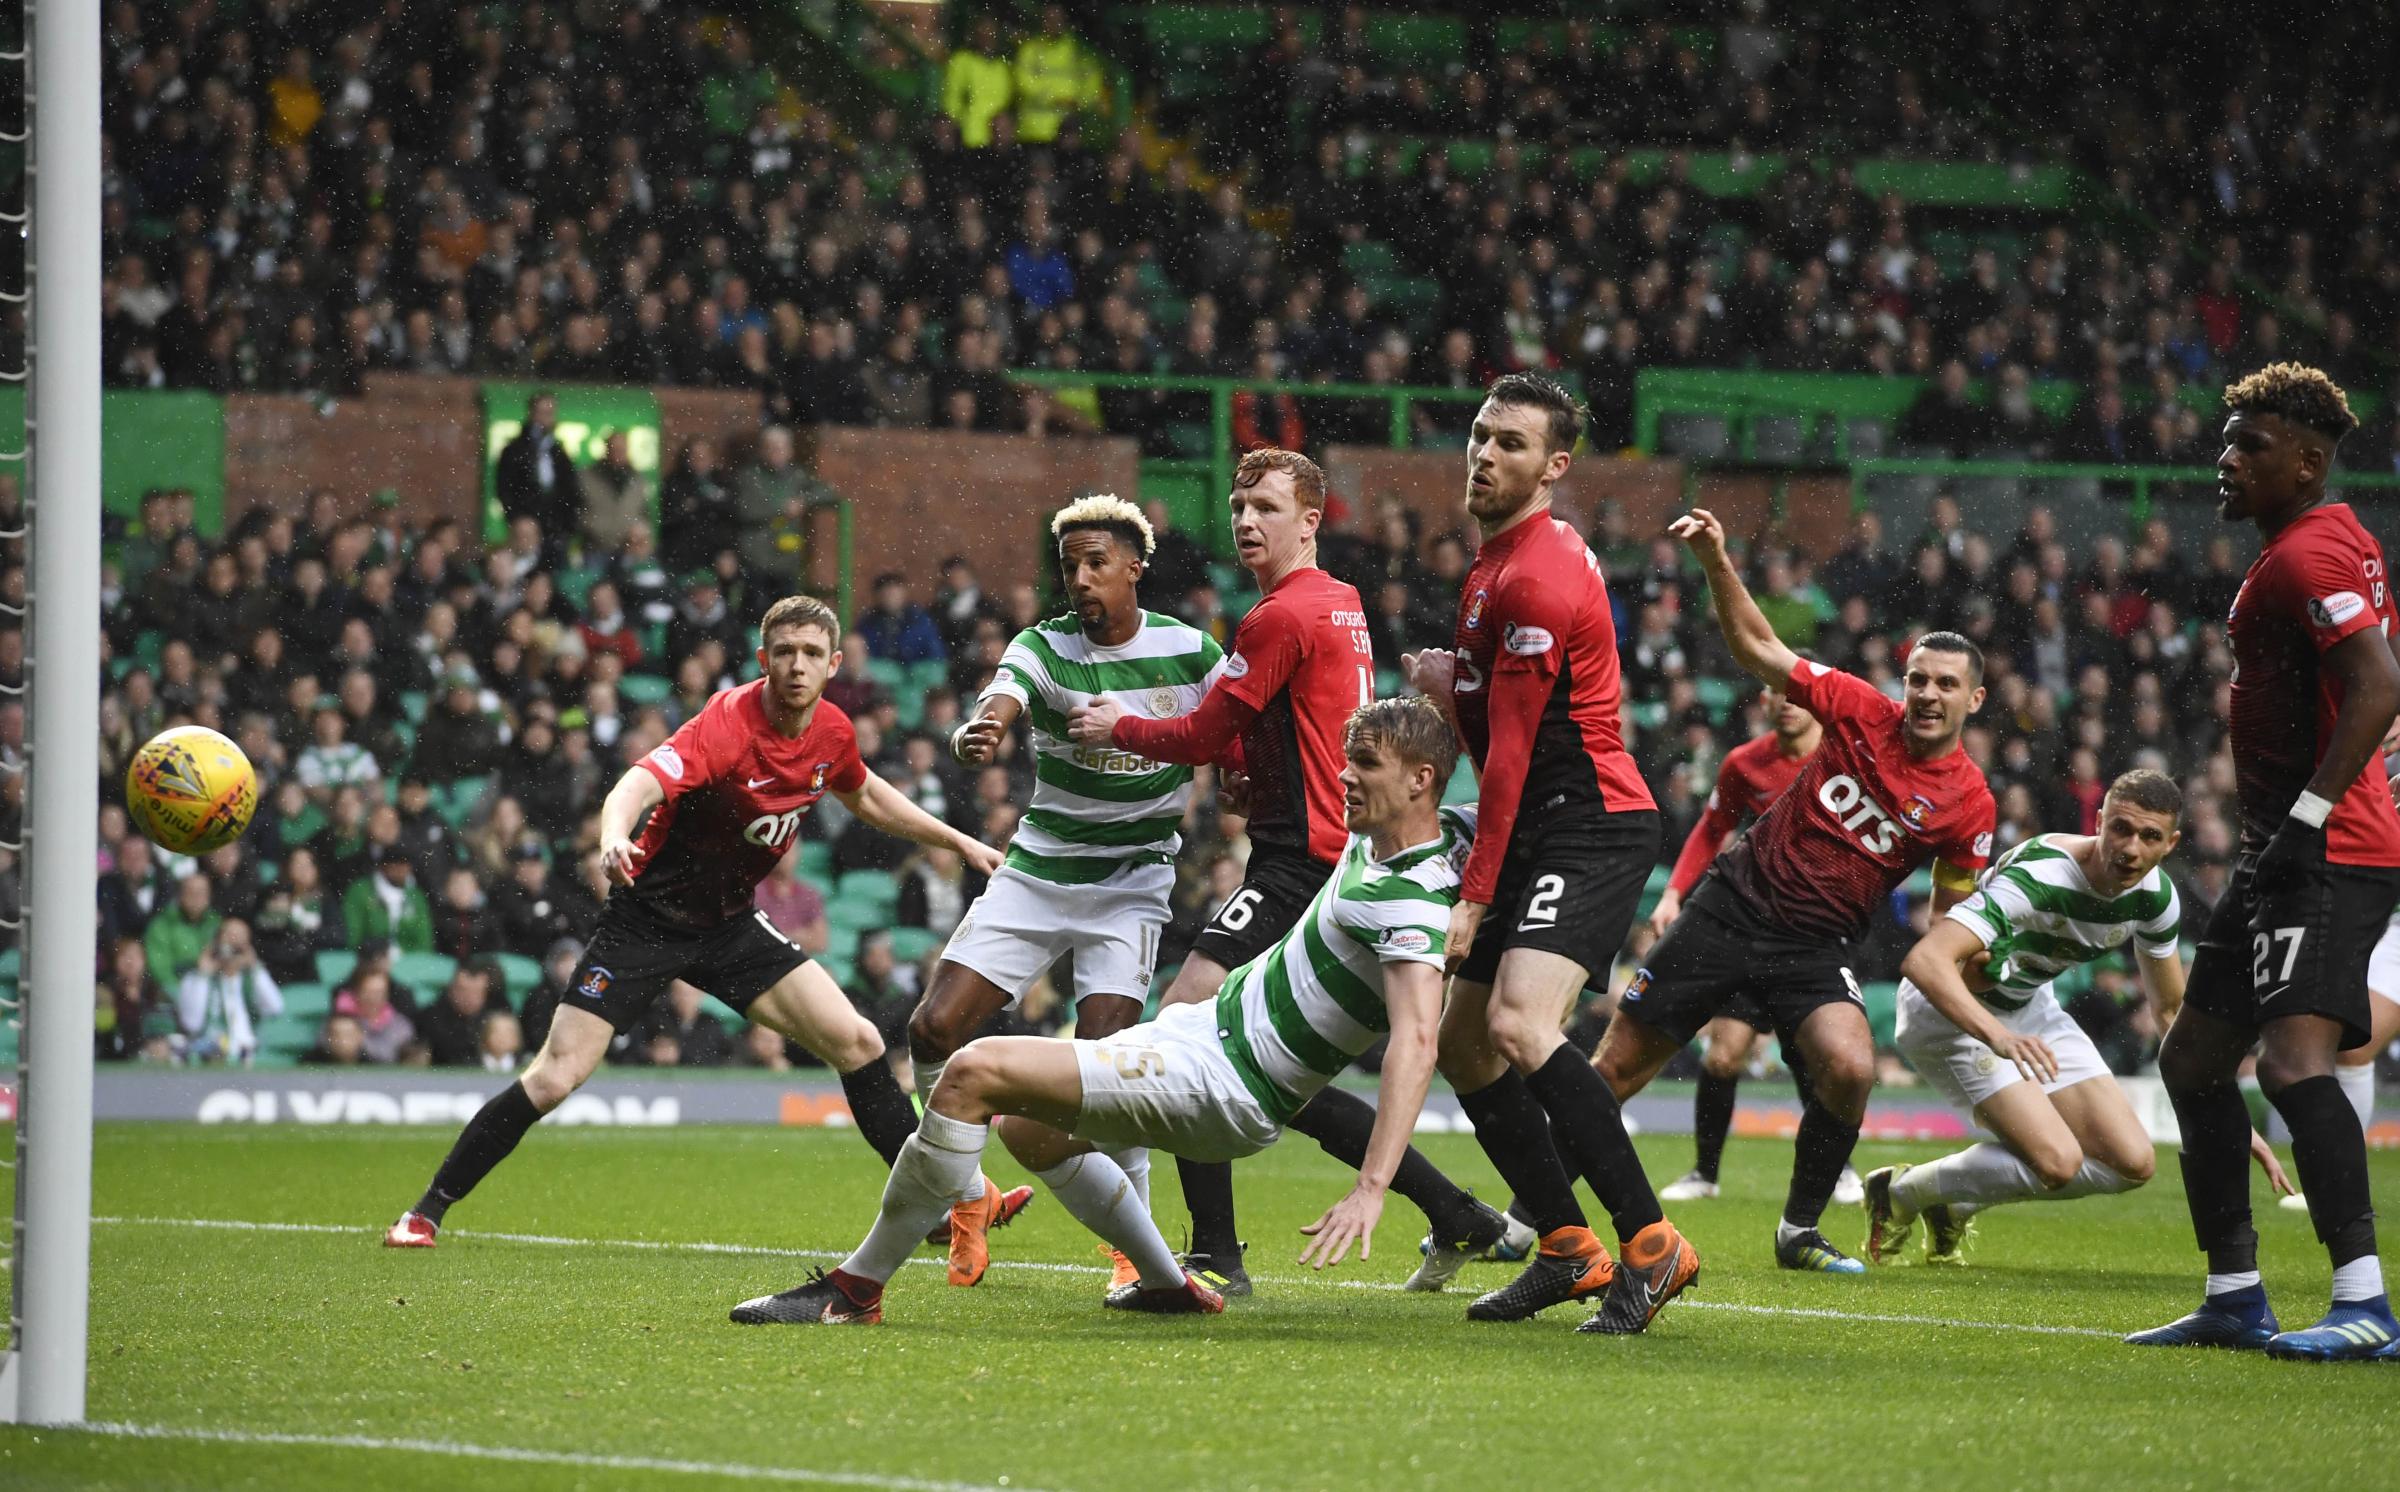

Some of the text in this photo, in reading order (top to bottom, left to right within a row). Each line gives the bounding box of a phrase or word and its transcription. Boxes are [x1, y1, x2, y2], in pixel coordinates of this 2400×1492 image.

[1819, 774, 1906, 854] QTS
[1526, 873, 1566, 922] 2
[2252, 927, 2307, 988] 27
